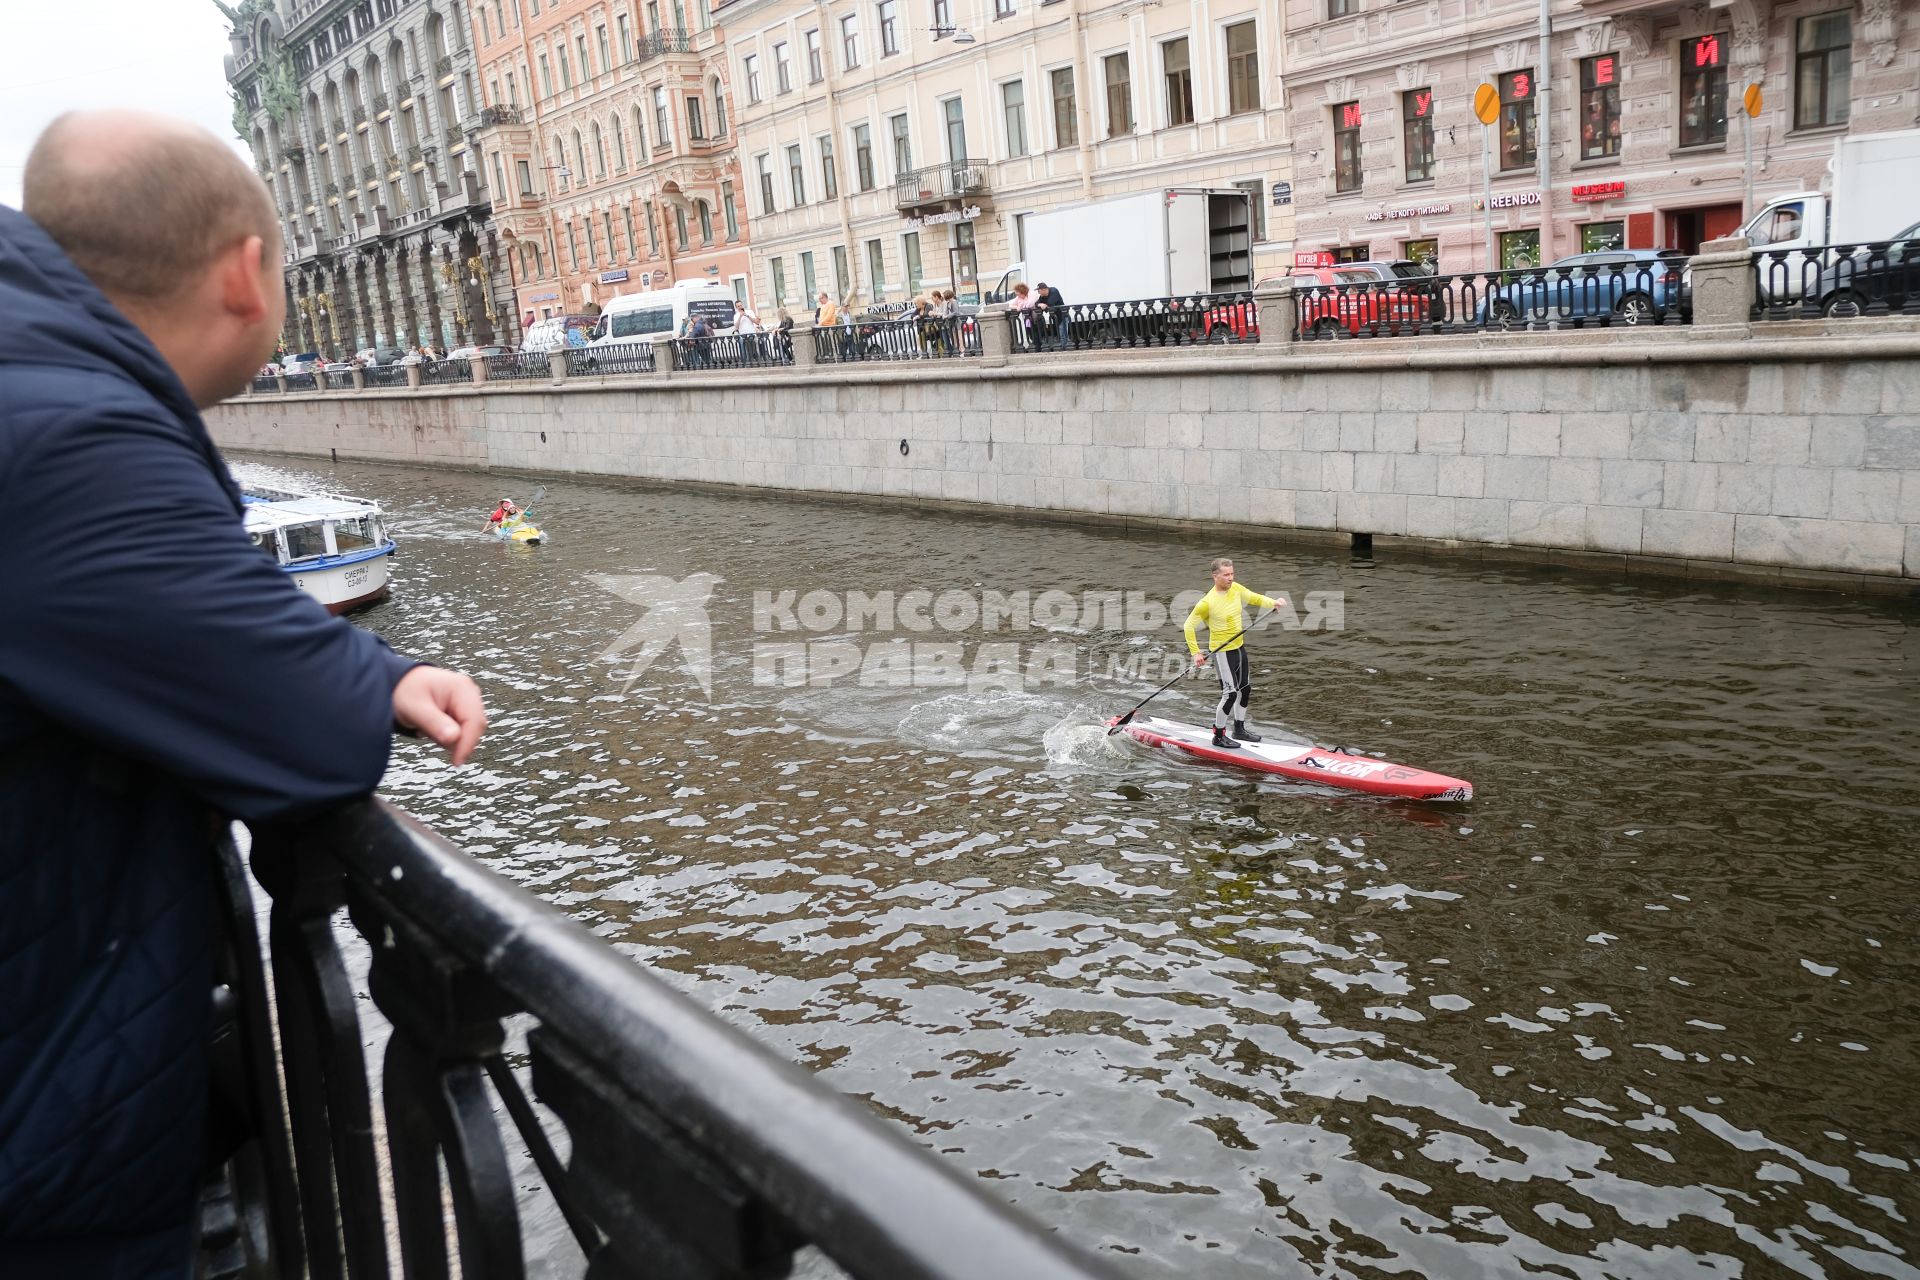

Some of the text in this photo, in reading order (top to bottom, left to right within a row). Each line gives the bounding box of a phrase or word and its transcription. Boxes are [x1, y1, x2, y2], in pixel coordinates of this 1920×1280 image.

[1572, 182, 1625, 196] MUSEUM
[1365, 204, 1451, 221] КАФЕ ЛЕГКОГО ПИТАНИЯ
[1297, 254, 1318, 264] МУЗЕЙ
[867, 302, 906, 314] GENTLEMEN
